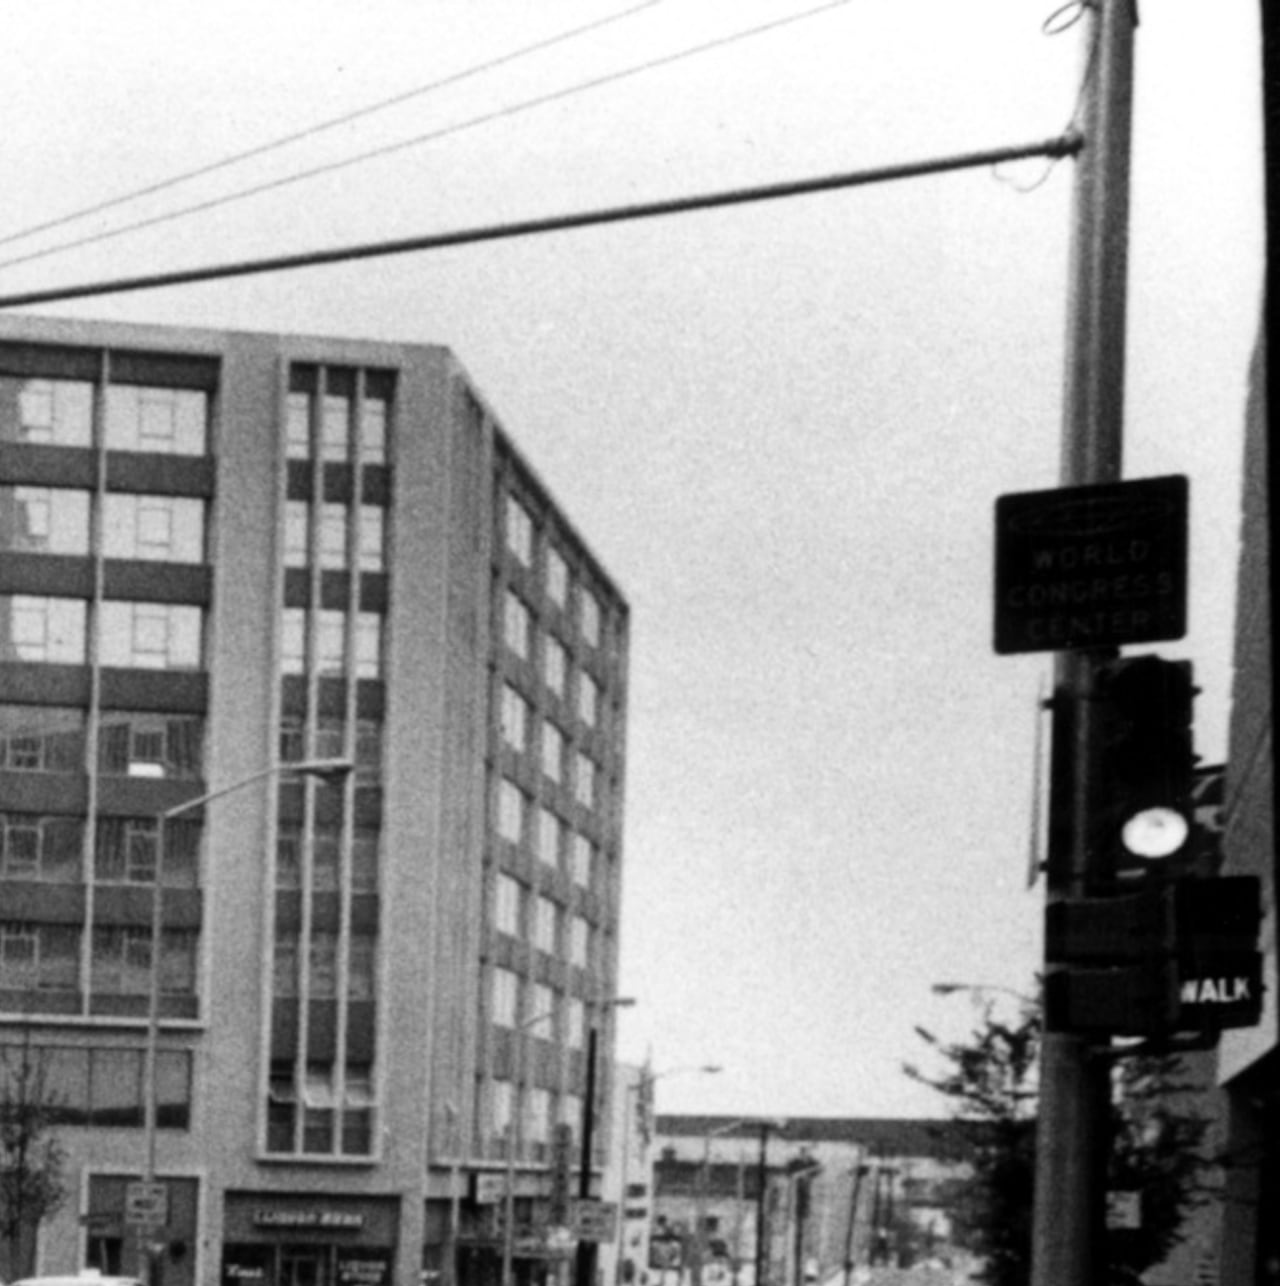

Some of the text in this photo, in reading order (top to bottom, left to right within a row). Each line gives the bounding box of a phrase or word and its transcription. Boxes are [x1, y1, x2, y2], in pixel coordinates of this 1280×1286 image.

[1033, 539, 1152, 570] WORLD
[1007, 571, 1175, 608] CONGRESS
[1026, 609, 1152, 642] CENTER
[1180, 977, 1251, 1004] WALK
